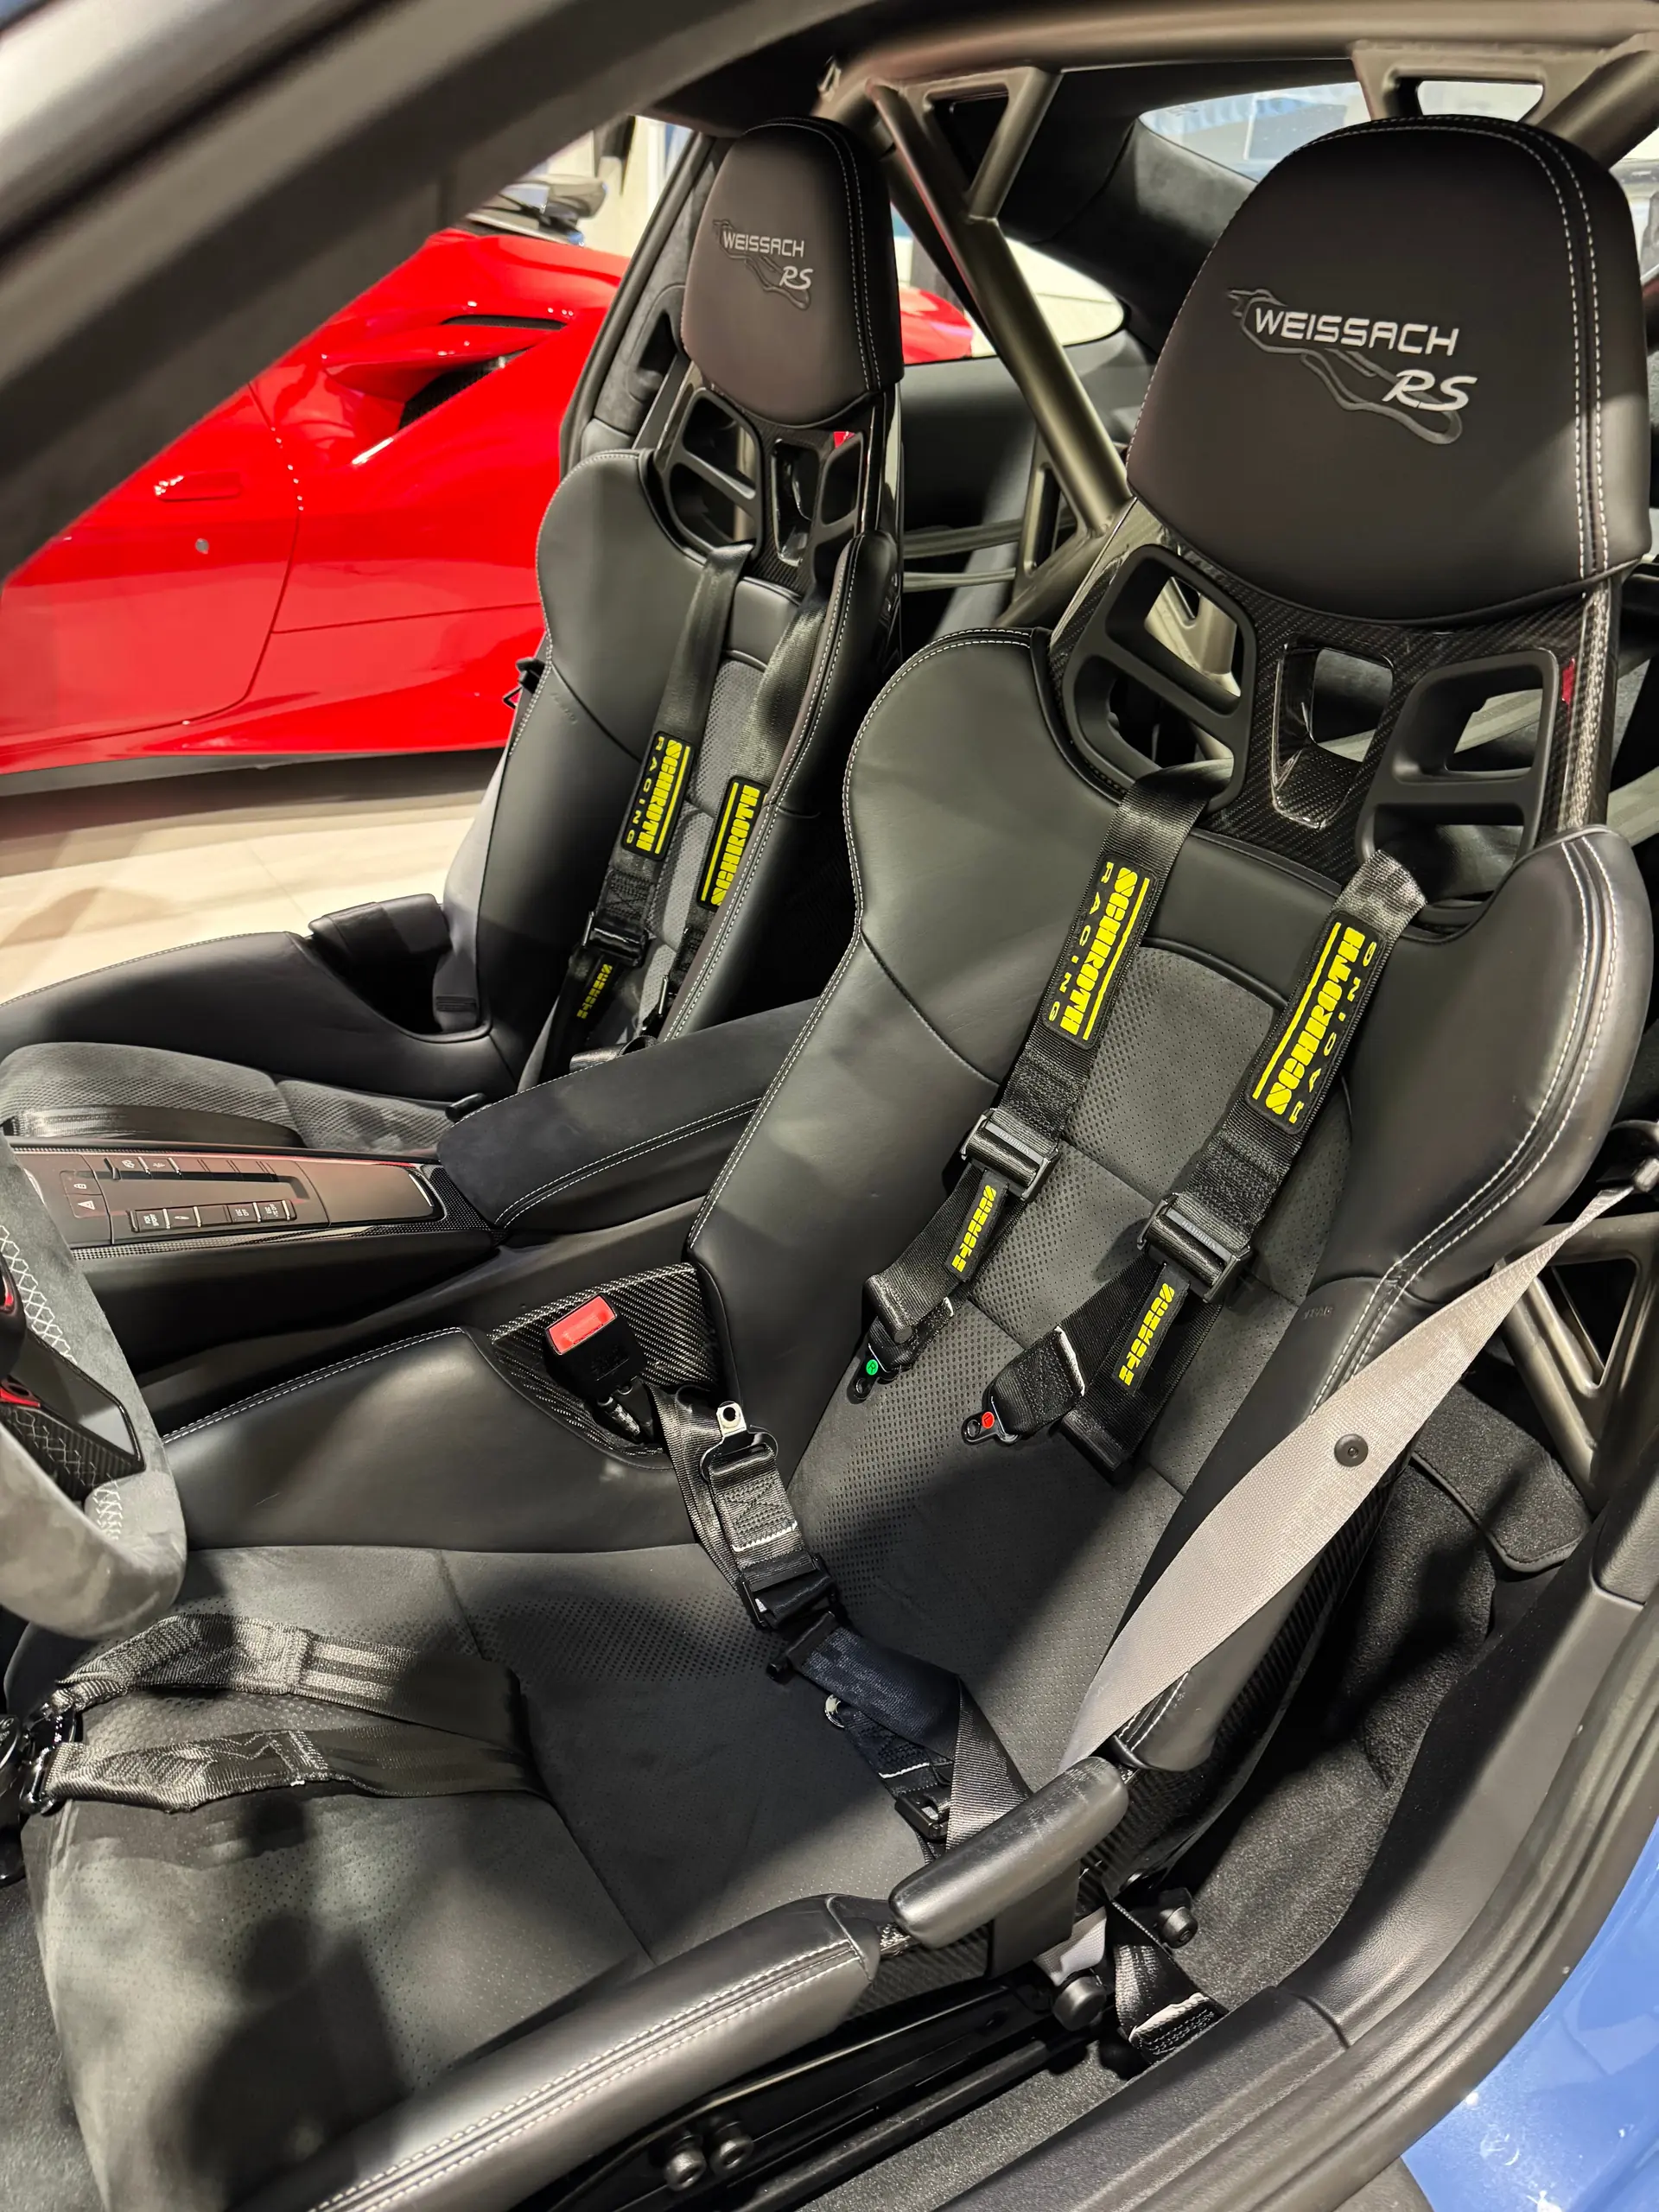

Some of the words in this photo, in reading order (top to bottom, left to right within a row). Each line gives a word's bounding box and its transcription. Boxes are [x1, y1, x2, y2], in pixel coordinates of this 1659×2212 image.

[722, 230, 804, 257] WEISSACH
[779, 265, 813, 290] RS
[1255, 307, 1459, 356] WEISSACH
[1382, 369, 1478, 411] RS
[626, 736, 664, 844] RACING
[636, 739, 683, 852] SCHROTH
[710, 785, 761, 906] SCHROTH
[1048, 861, 1114, 1022] RACING
[1059, 867, 1138, 1036] SCHROTH
[1265, 926, 1366, 1116] SCHROTH
[1288, 941, 1376, 1124] RACING
[951, 1185, 996, 1273] SCHROTH
[1119, 1284, 1176, 1386] SCHROTH
